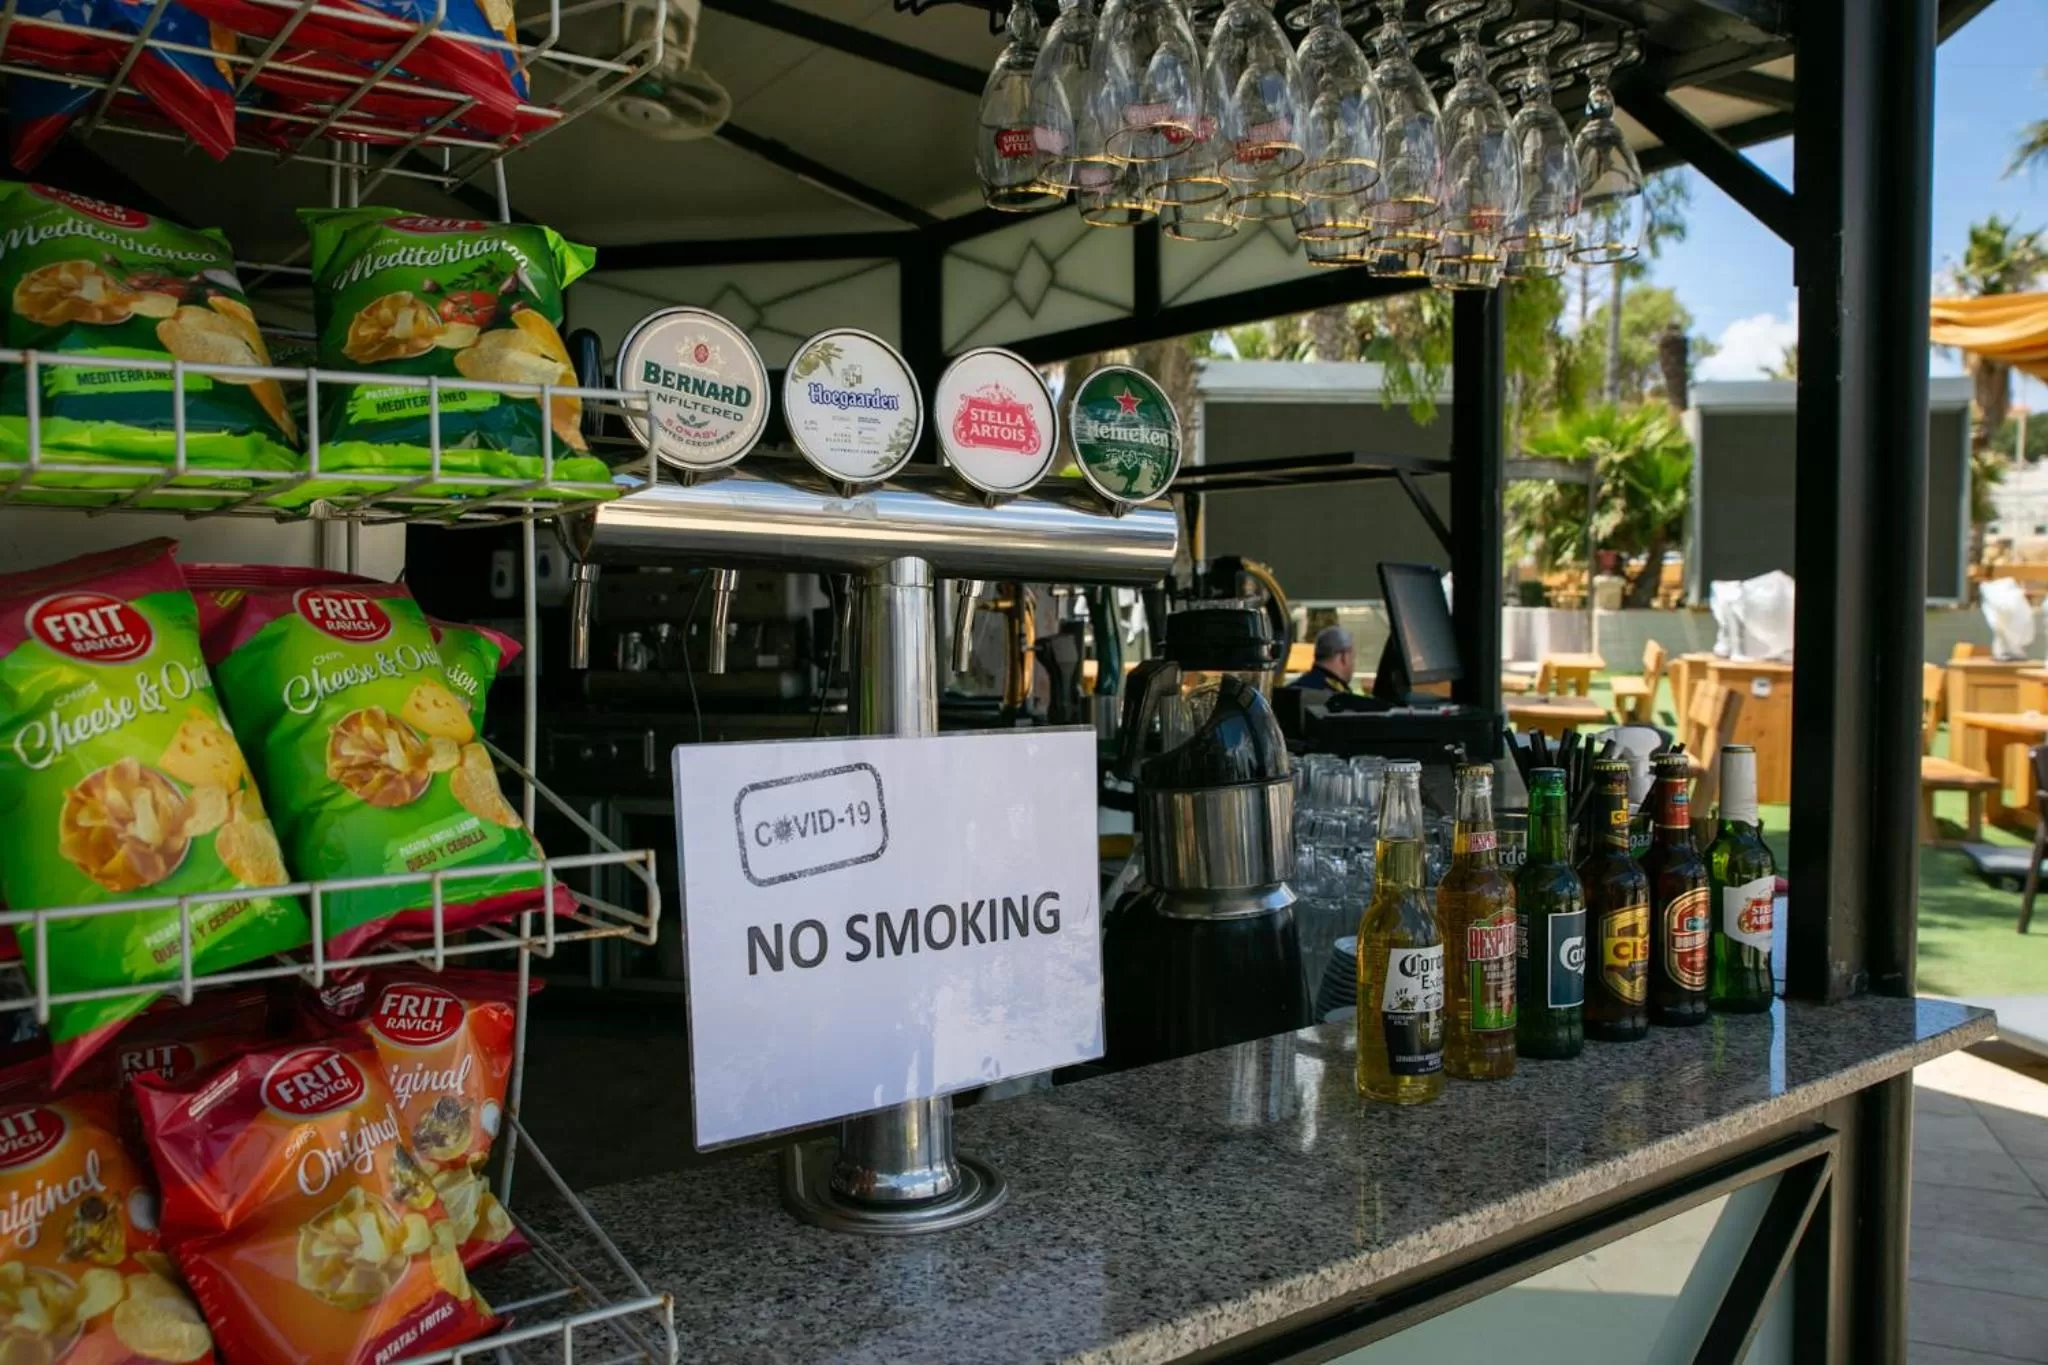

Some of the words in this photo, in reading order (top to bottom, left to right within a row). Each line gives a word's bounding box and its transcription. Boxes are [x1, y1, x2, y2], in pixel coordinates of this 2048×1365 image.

[642, 360, 752, 408] BERNARD
[807, 382, 899, 411] Hoegaarden
[656, 392, 744, 422] NFILTERED
[970, 407, 1025, 427] STELLA
[969, 422, 1026, 442] ARTOIS
[1086, 420, 1170, 448] Heineken
[43, 603, 126, 643] FRIT
[307, 597, 369, 620] FRIT
[325, 619, 377, 632] RAVICH
[71, 632, 134, 653] RAVICH
[283, 661, 378, 715] Cheese
[375, 650, 404, 679] &
[13, 695, 137, 770] Cheese
[136, 672, 167, 713] &
[747, 919, 828, 976] NO
[845, 891, 1061, 963] SMOKING
[380, 993, 453, 1019] FRIT
[386, 1016, 443, 1033] RAVICH
[121, 1044, 179, 1070] RIT
[276, 1053, 346, 1104] FRIT
[298, 1077, 353, 1110] RAVICH
[389, 1053, 473, 1110] iginal
[297, 1103, 403, 1196] Original
[375, 1326, 418, 1365] PATATAS
[419, 1301, 455, 1337] FRITAS
